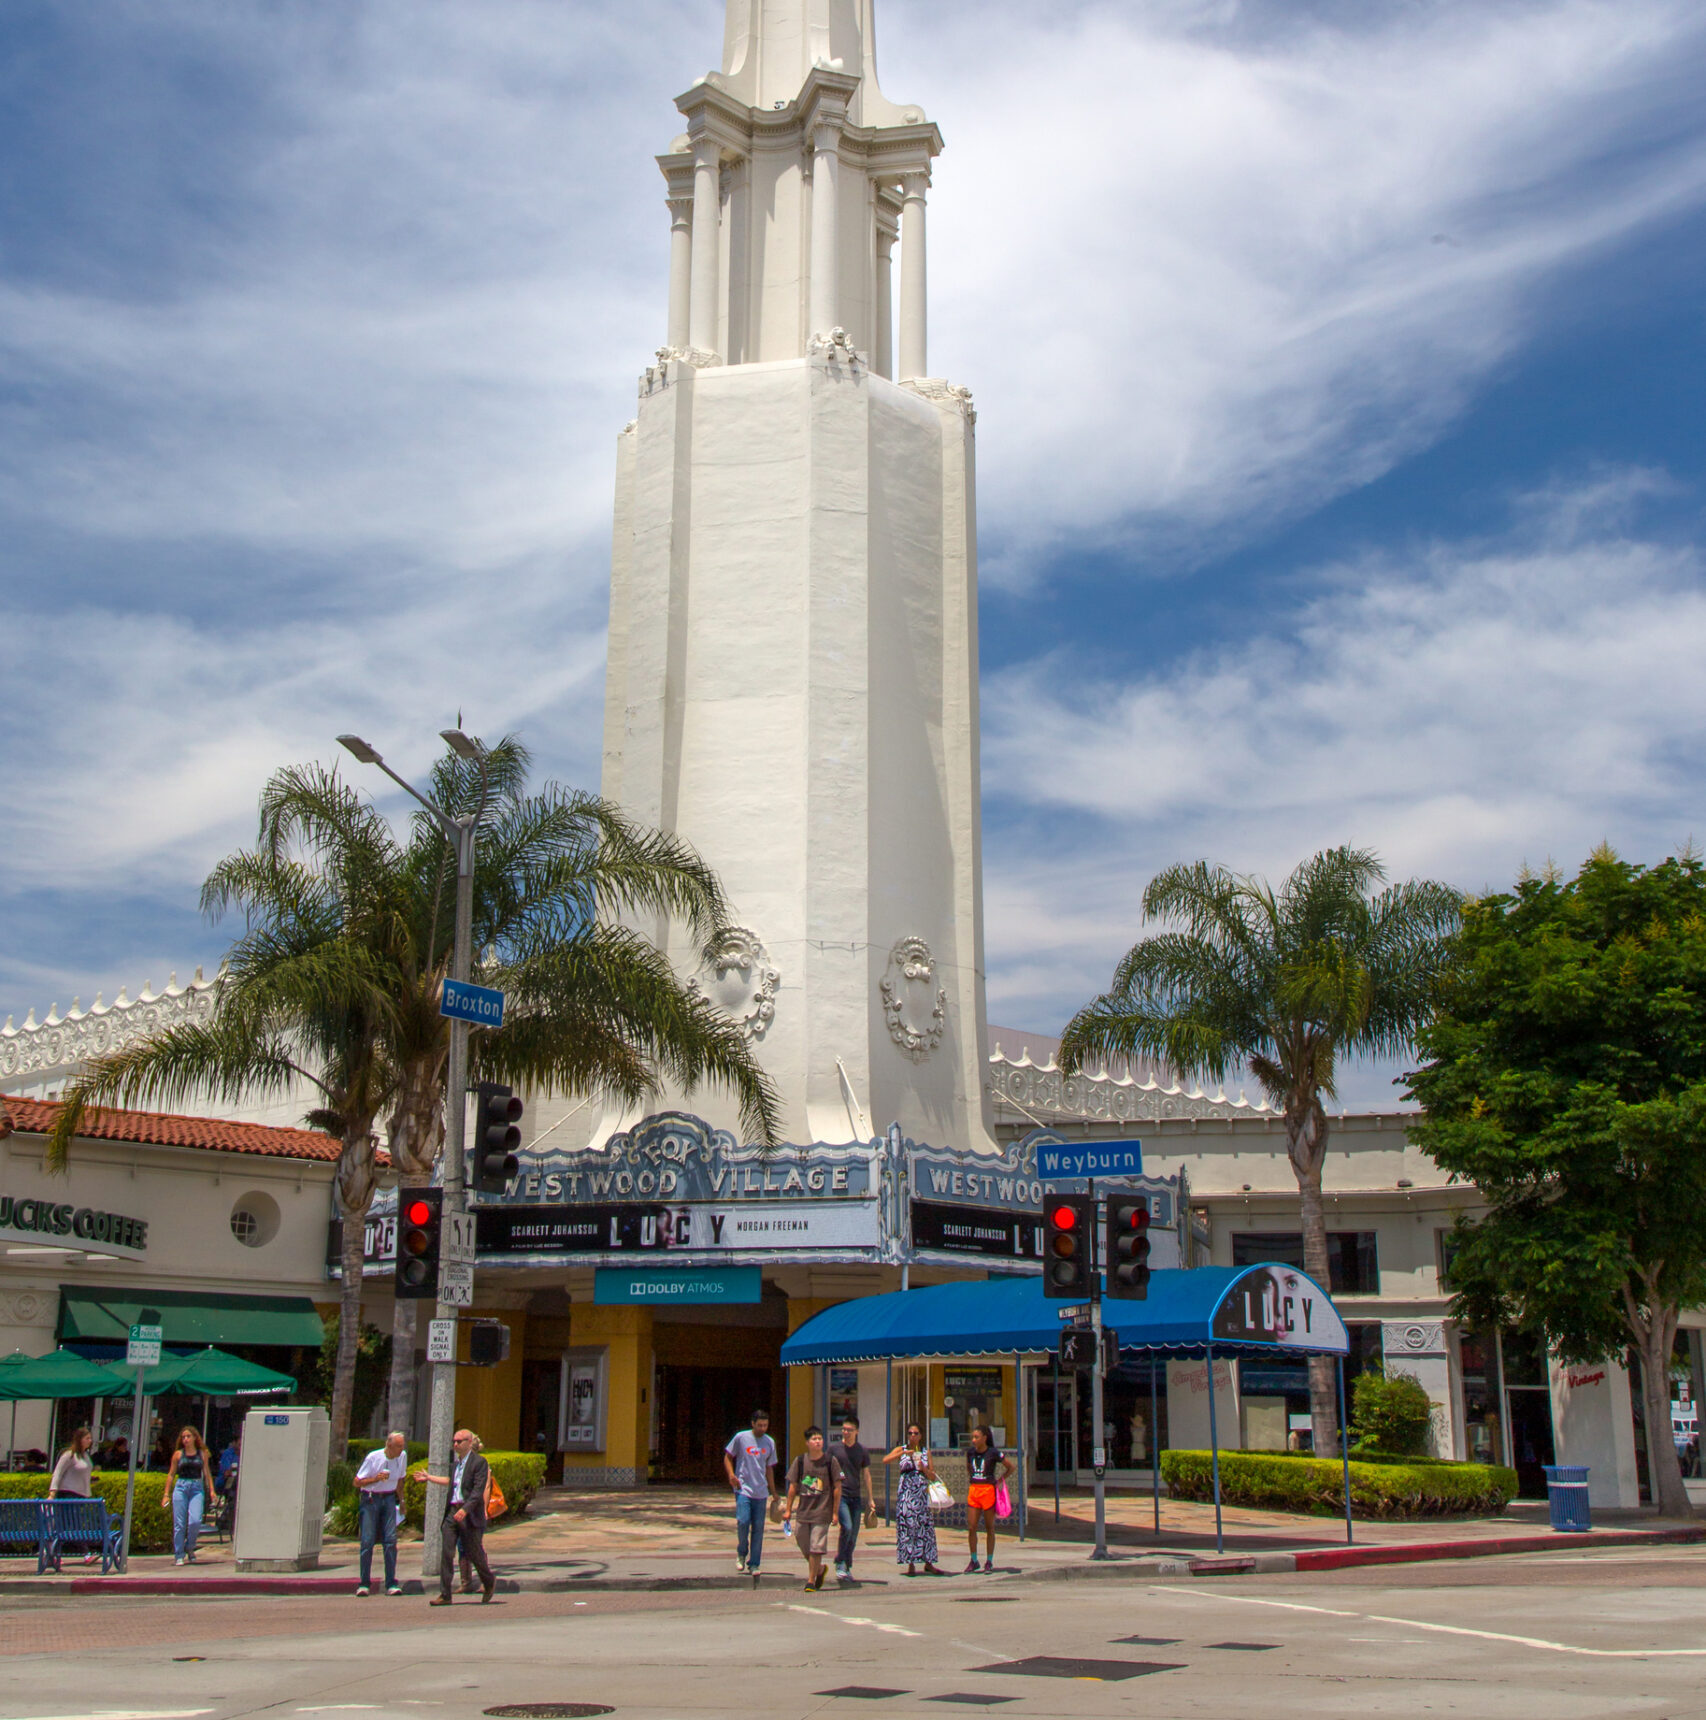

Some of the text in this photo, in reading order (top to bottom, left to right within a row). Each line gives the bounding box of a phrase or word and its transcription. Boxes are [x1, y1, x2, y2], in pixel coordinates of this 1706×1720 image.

[446, 988, 500, 1018] Broxton
[643, 1136, 698, 1166] FOX
[1044, 1151, 1135, 1174] Weyburn
[707, 1165, 848, 1193] VILLAGE
[511, 1223, 598, 1237] SCARLETT JOHANSSON
[609, 1214, 726, 1246] LUCY
[737, 1220, 809, 1232] MORGAN FREEMAN
[943, 1223, 1006, 1241] SCARLETT JOHANSSON
[443, 1285, 456, 1301] OK
[647, 1282, 725, 1294] DOLBY ATMOS
[1244, 1291, 1313, 1334] LUCY
[131, 1326, 139, 1337] 2
[430, 1343, 450, 1351] SIGNAL
[432, 1351, 448, 1359] ONLY
[945, 1376, 966, 1385] LUCY
[1568, 1371, 1605, 1388] Vintage
[573, 1379, 594, 1398] LUCY
[275, 1416, 289, 1424] 150
